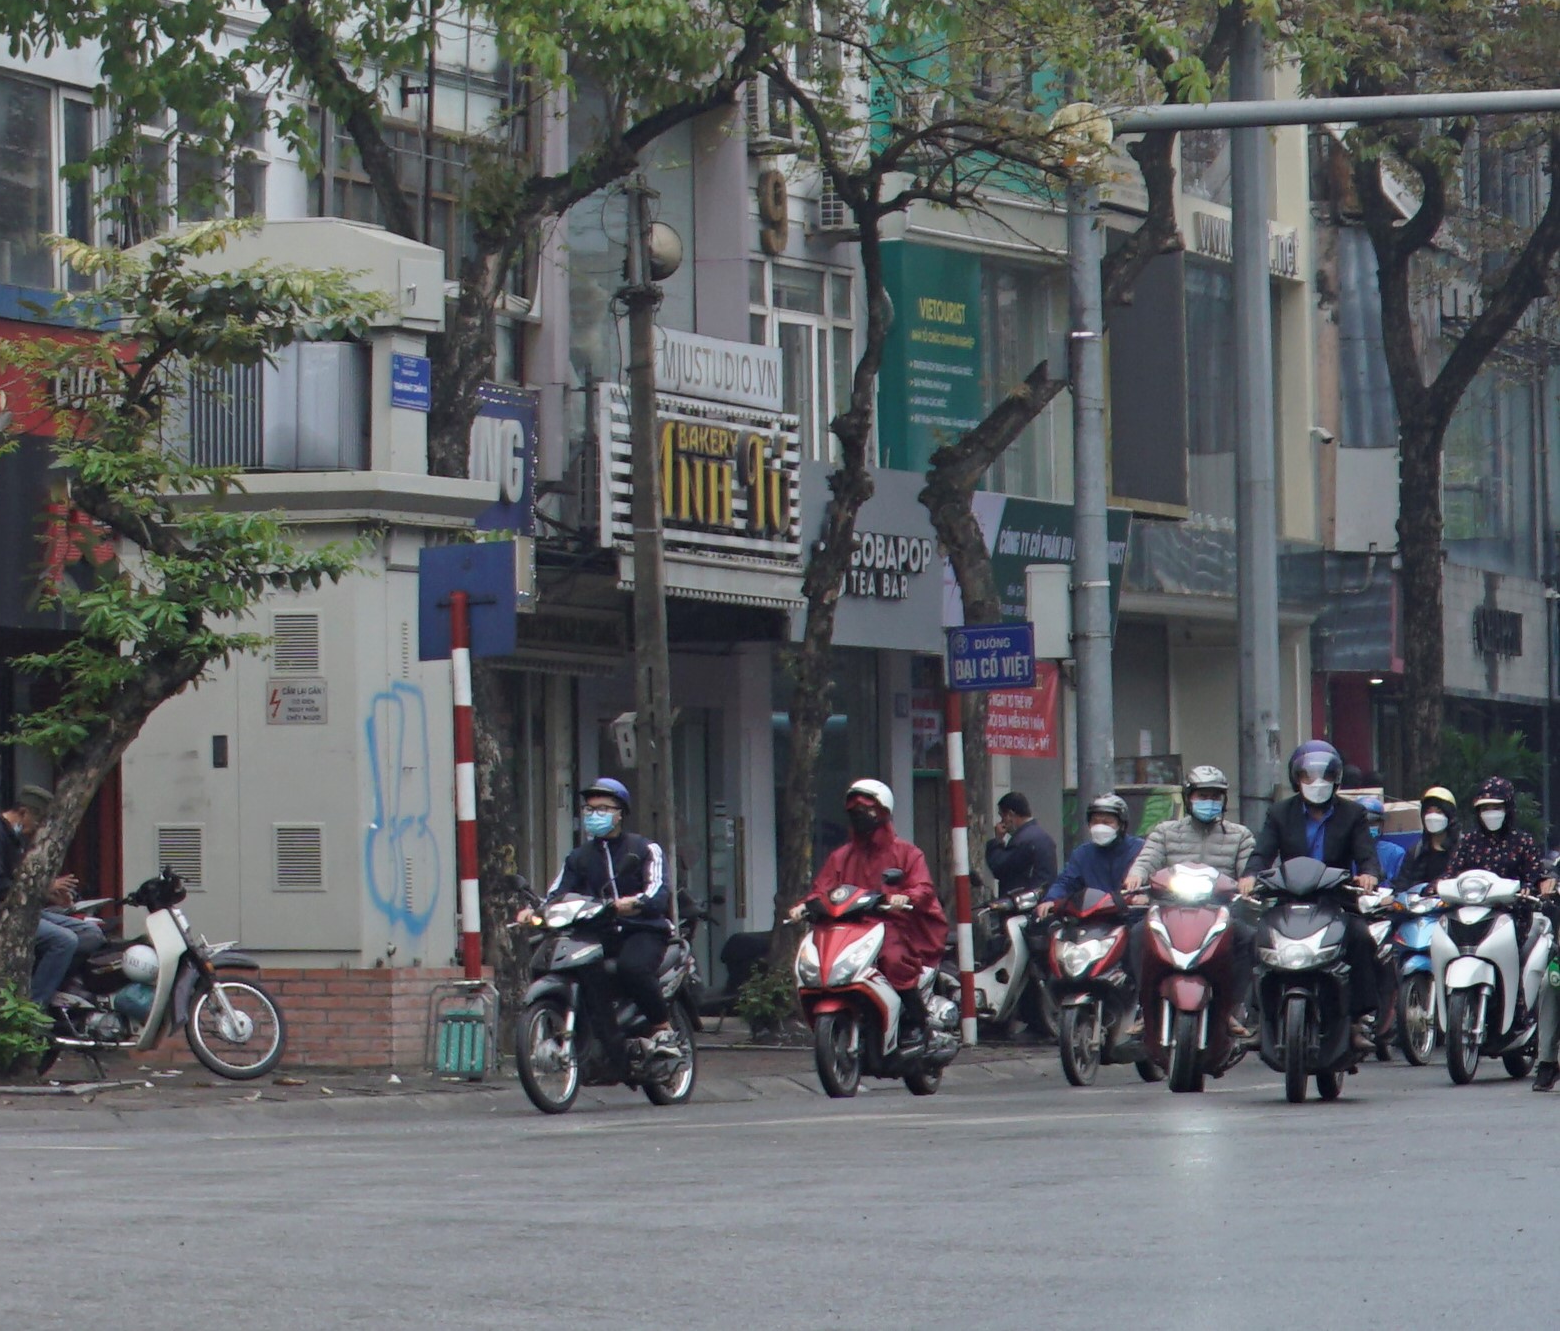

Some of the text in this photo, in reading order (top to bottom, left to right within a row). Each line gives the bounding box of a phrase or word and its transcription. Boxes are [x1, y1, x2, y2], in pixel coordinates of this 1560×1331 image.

[663, 338, 779, 400] MJUSTUDIO.VN
[678, 422, 740, 457] BAKERY
[851, 570, 908, 598] TEA BAR
[955, 660, 977, 684] ĐẠI
[1002, 651, 1031, 682] VIỆT
